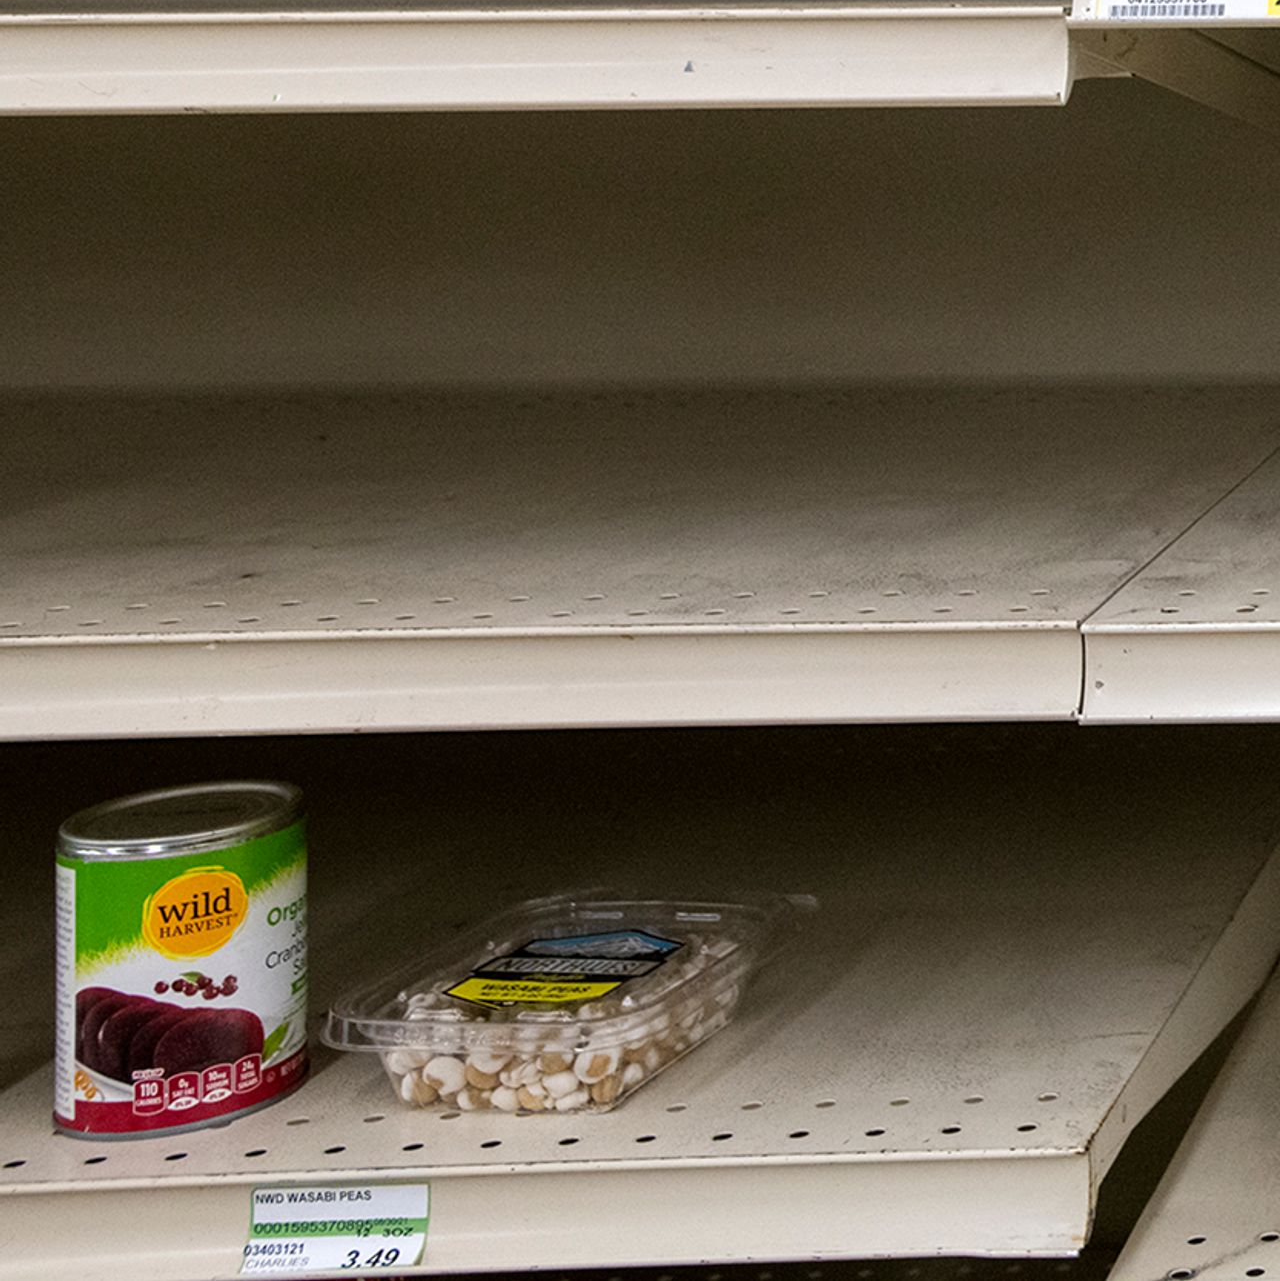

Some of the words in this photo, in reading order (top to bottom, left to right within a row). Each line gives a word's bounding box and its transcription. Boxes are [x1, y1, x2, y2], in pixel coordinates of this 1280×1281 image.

[158, 887, 232, 923] wild
[159, 917, 232, 939] HARVEST
[140, 1084, 158, 1097] 110
[255, 1194, 285, 1204] NWD
[287, 1192, 336, 1203] WASABI
[339, 1190, 372, 1201] PEAS
[243, 1243, 304, 1256] 03403121
[246, 1257, 309, 1269] CHARLIES
[341, 1248, 400, 1269] 3.49
